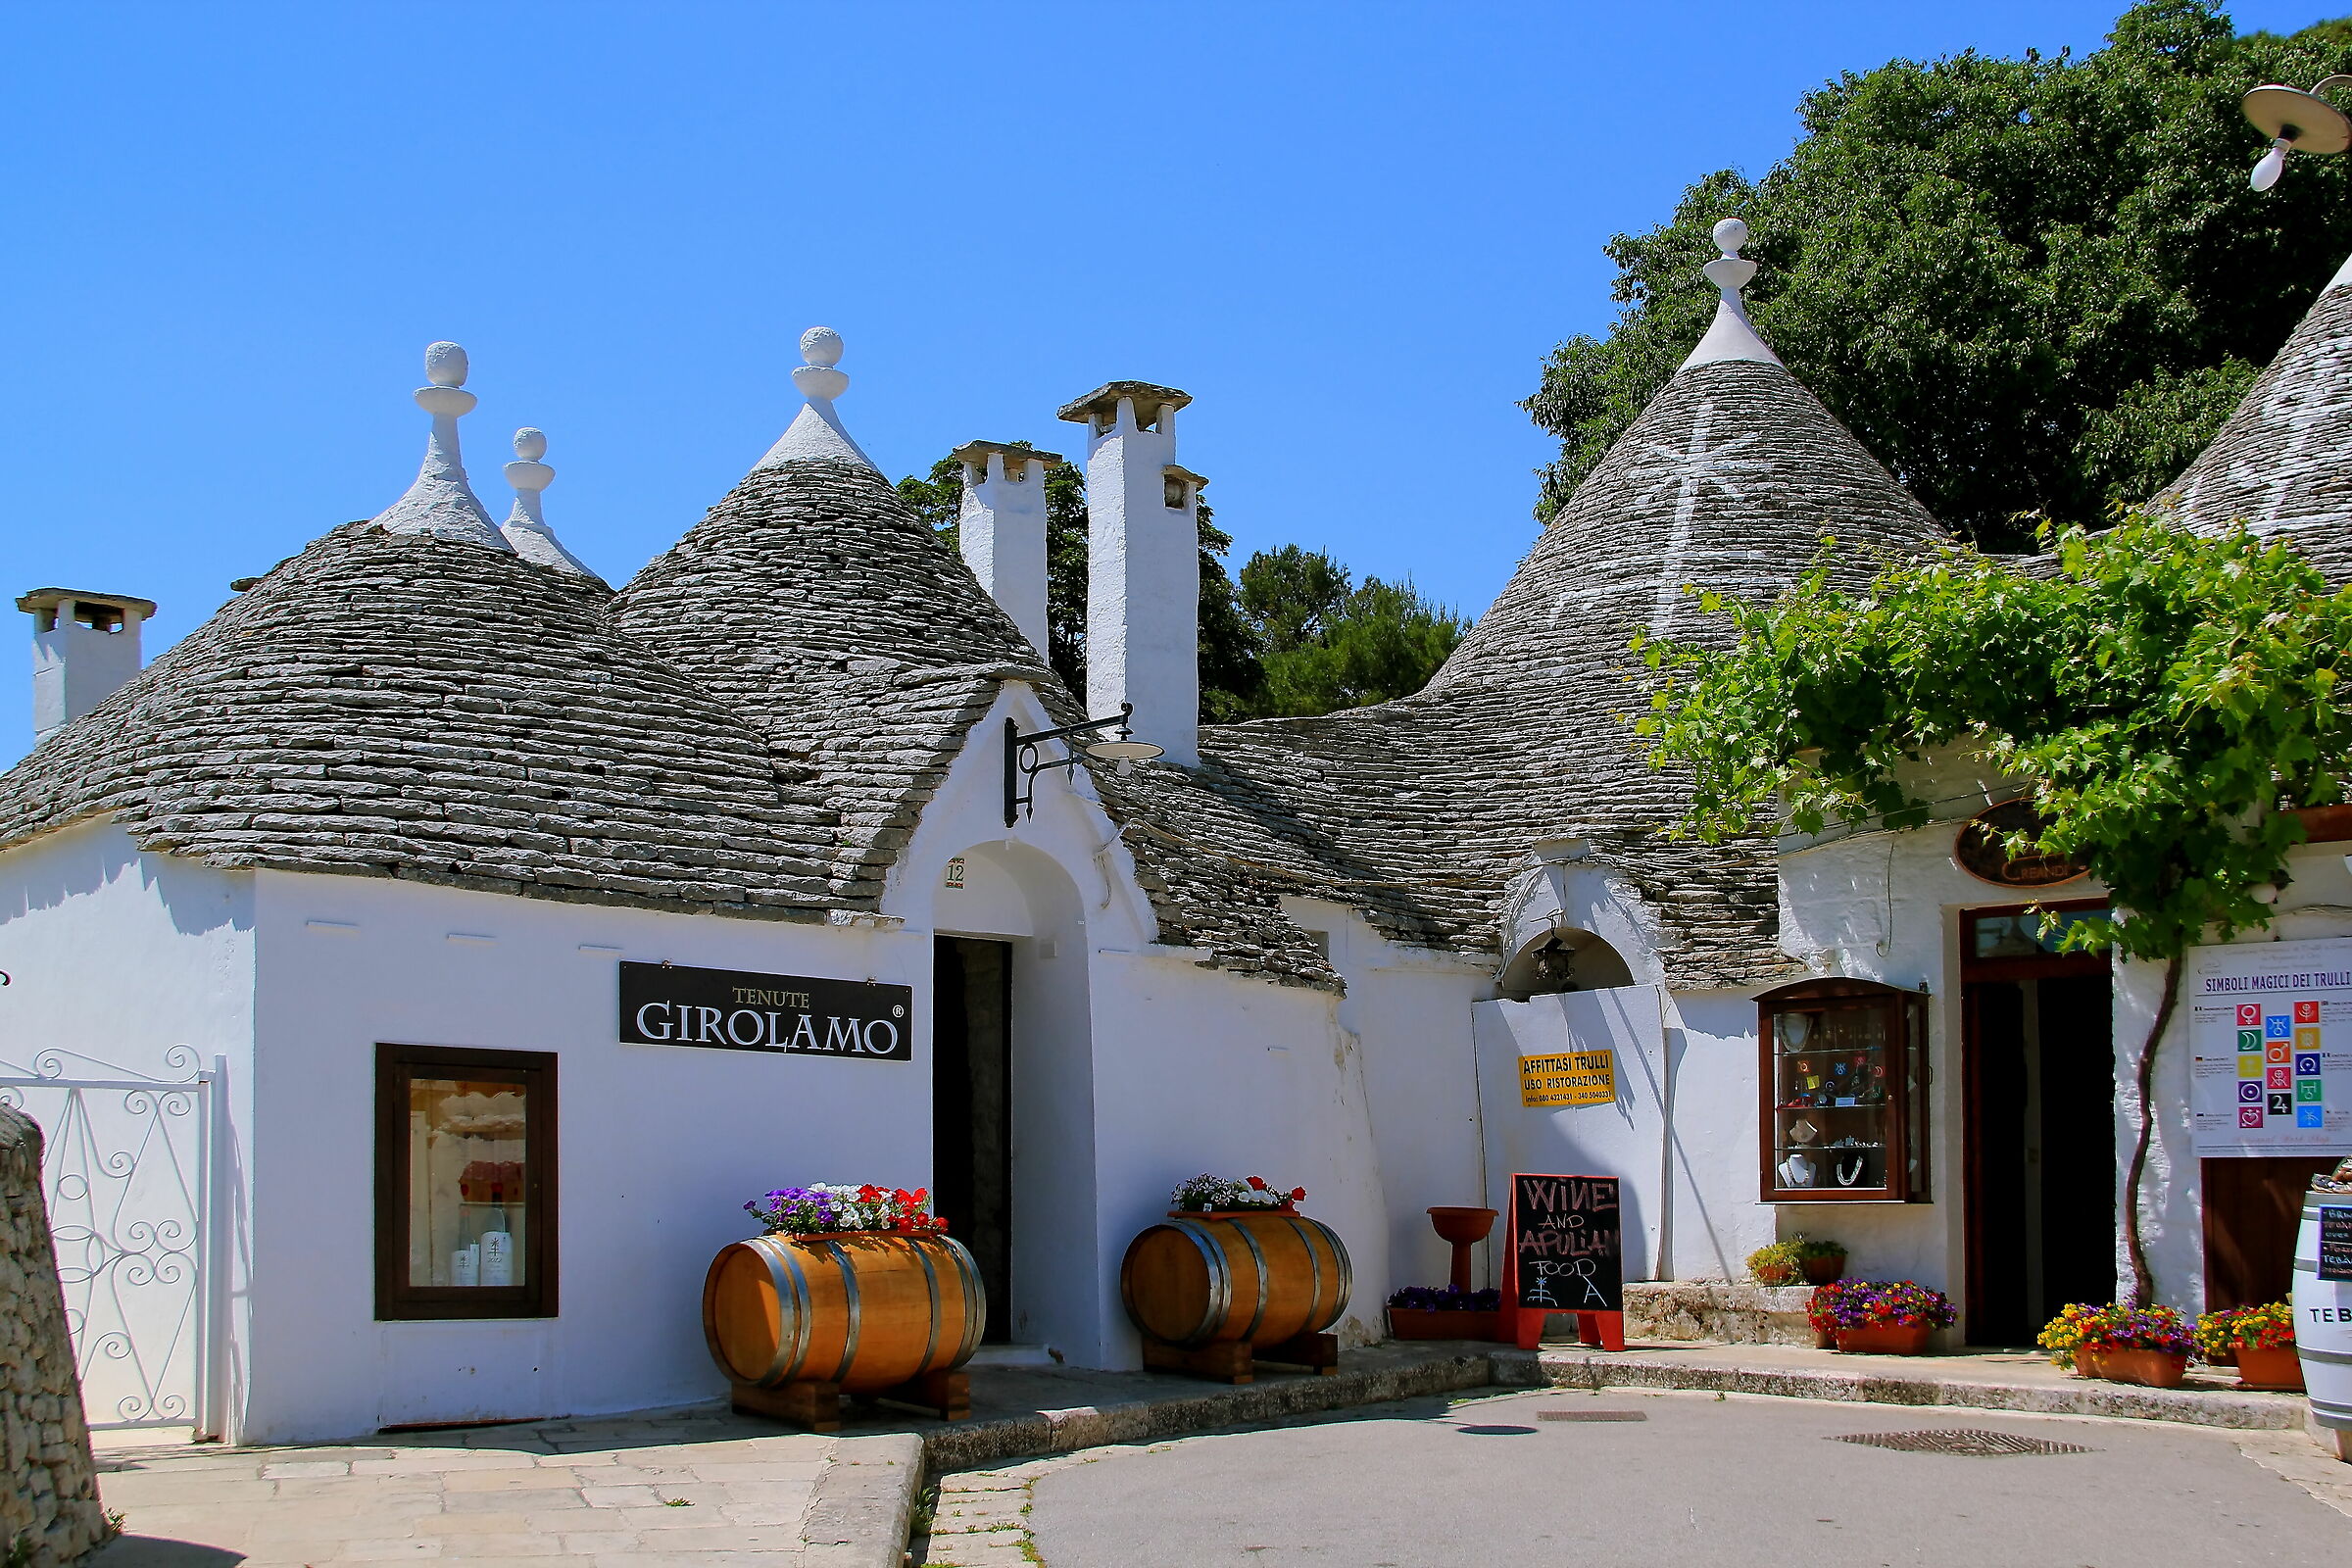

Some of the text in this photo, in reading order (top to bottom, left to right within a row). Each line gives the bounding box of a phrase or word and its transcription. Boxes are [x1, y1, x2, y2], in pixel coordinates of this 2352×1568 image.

[947, 864, 964, 882] 12
[2206, 971, 2351, 992] SIMBOLI MAGICI DEI TRULLI
[732, 986, 810, 1009] TENUTE
[636, 1000, 899, 1055] GIROLAMO
[1523, 1054, 1609, 1075] AFFITTASI TRULLI
[1524, 1074, 1610, 1091] USO RISTORAZIONE
[1538, 1213, 1584, 1230] AND
[1529, 1258, 1596, 1277] FOOD
